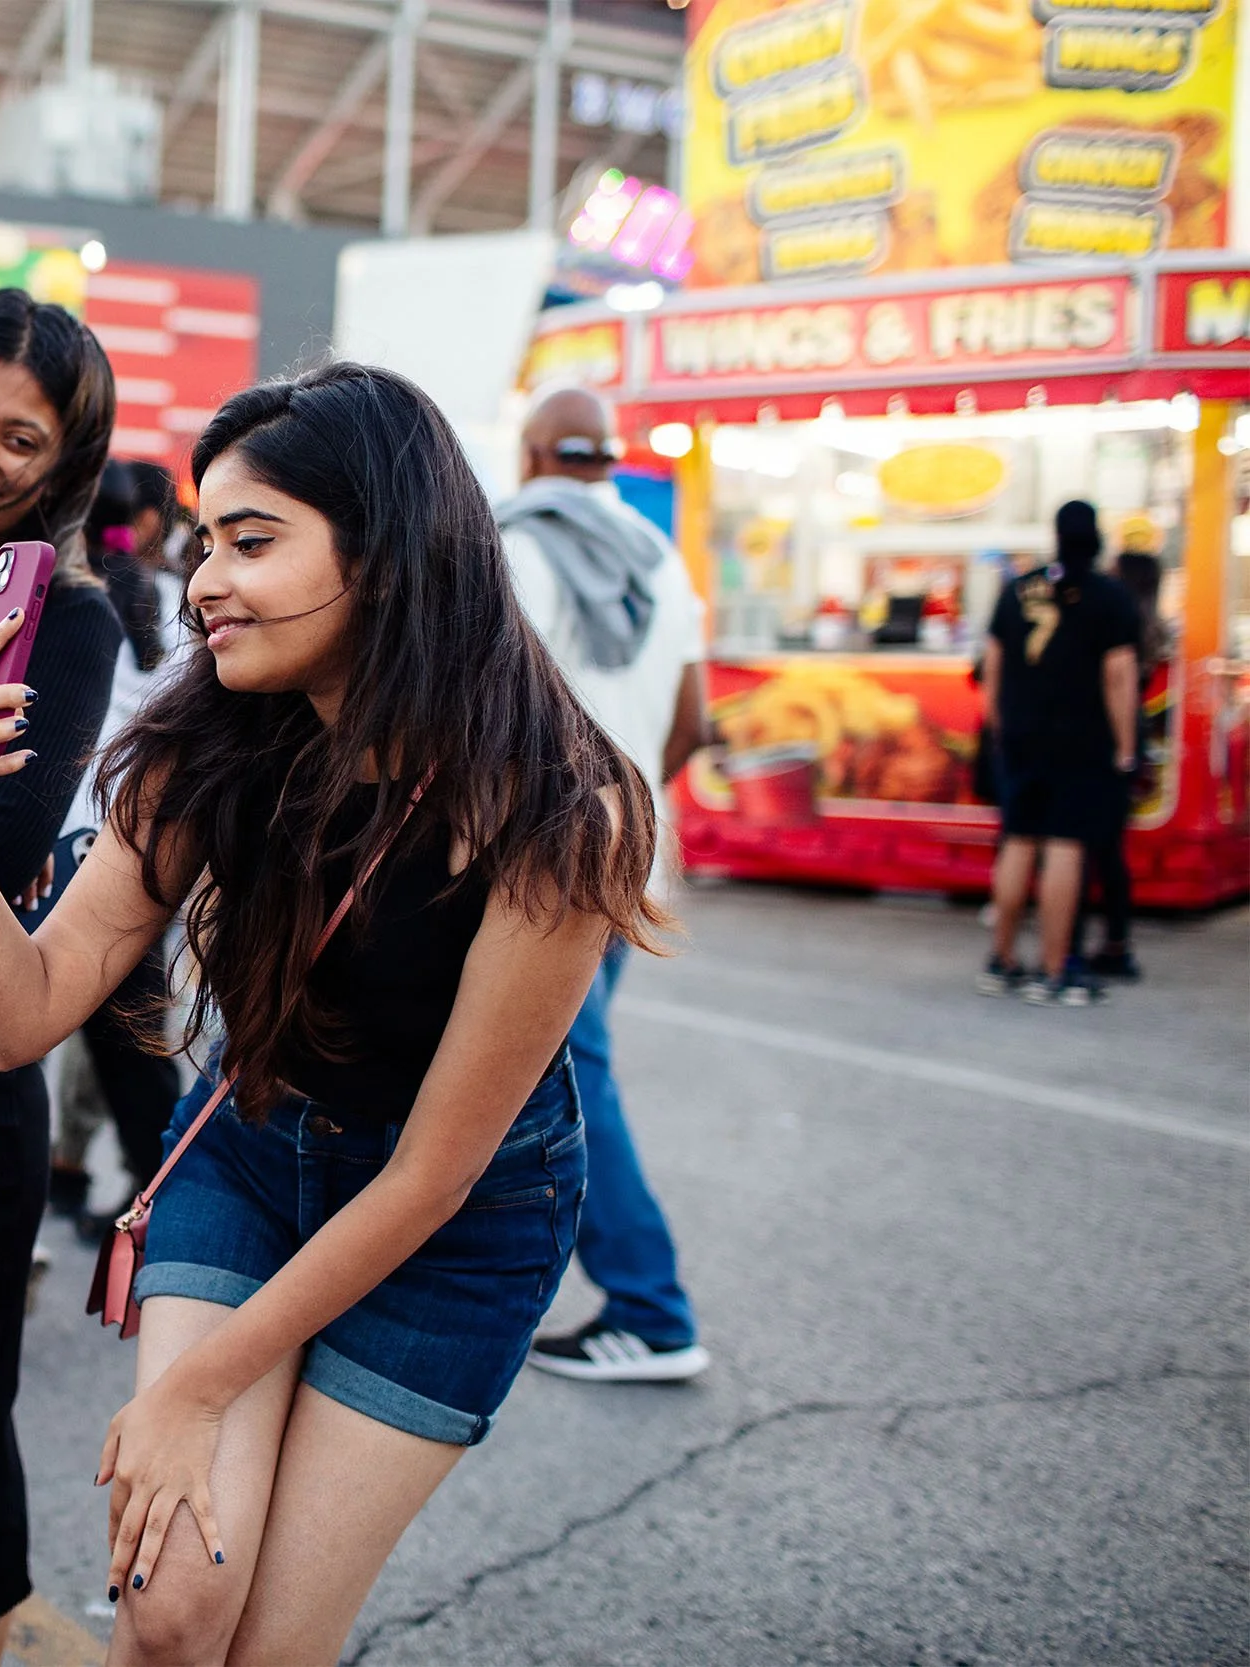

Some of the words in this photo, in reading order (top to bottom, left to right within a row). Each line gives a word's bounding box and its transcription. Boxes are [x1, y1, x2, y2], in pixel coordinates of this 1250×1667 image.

[661, 304, 851, 376] WINGS
[863, 302, 913, 366] &
[929, 283, 1117, 357] FRIES
